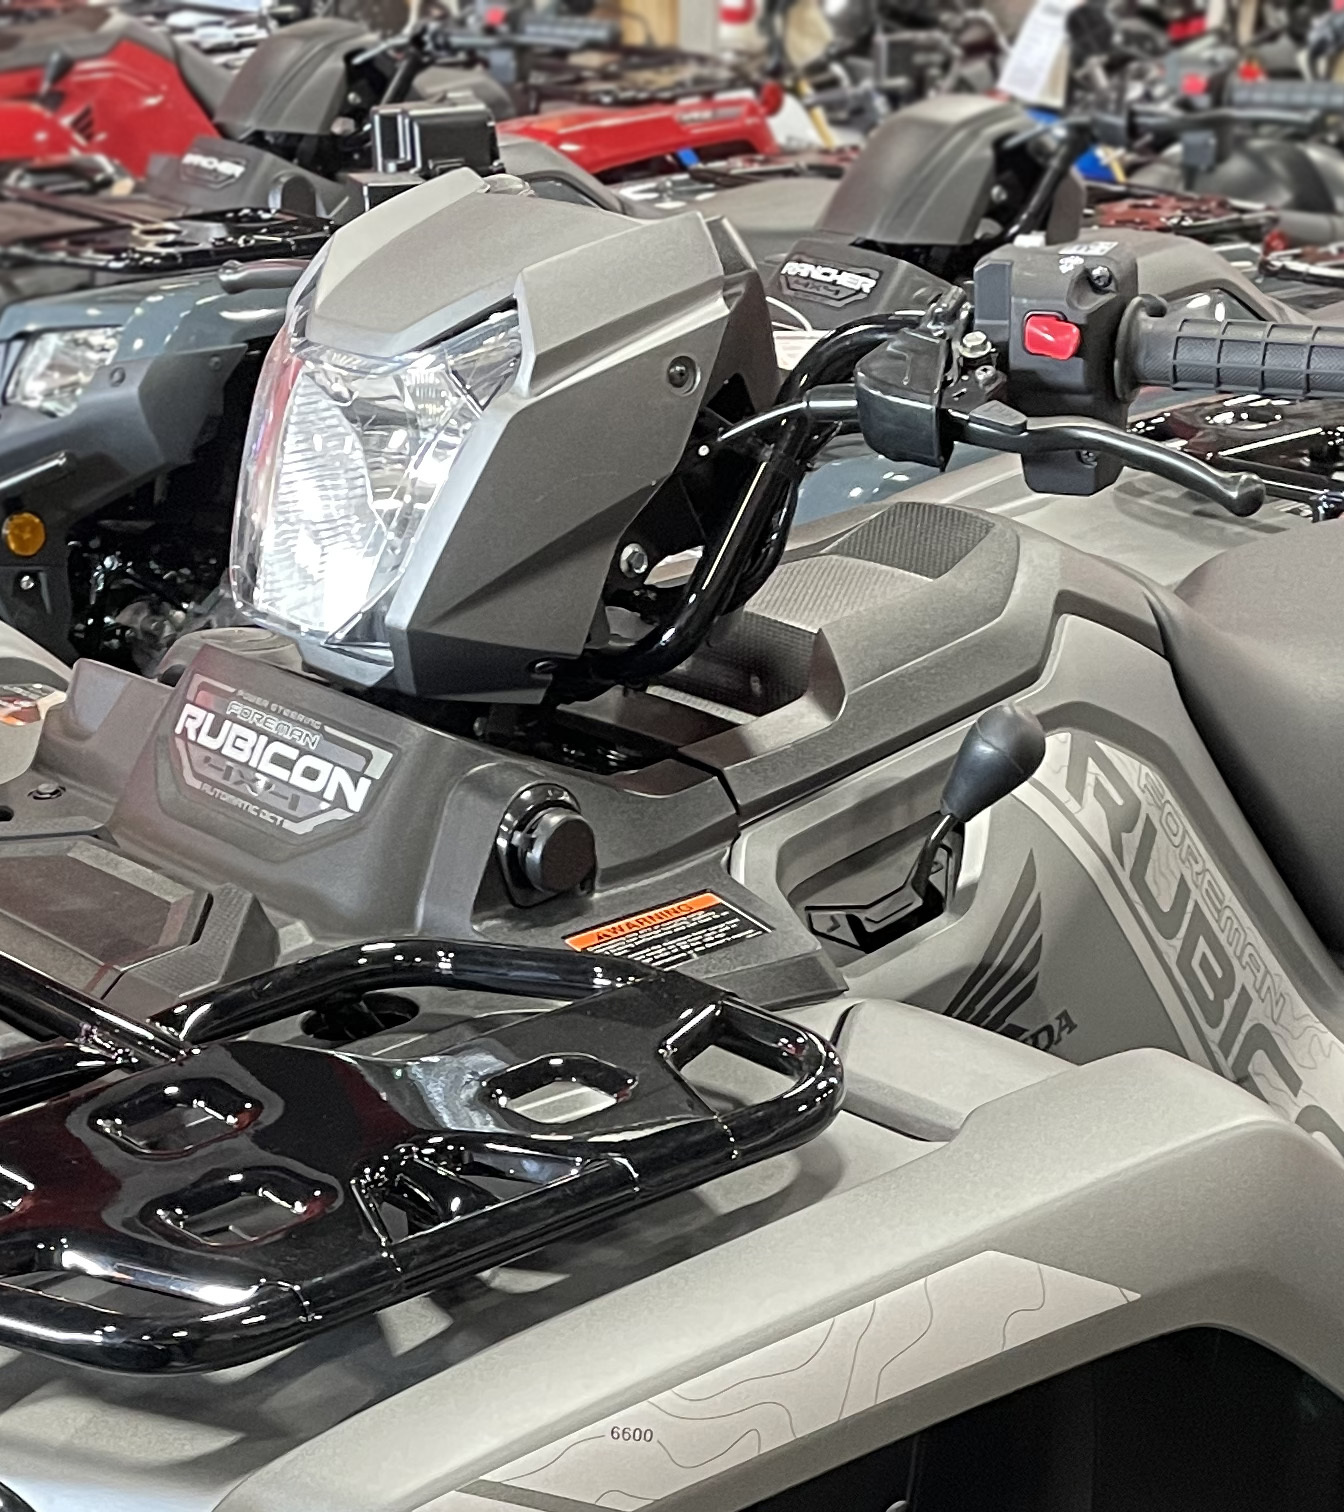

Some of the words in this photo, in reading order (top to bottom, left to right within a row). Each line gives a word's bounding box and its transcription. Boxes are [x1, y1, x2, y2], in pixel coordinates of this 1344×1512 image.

[226, 701, 323, 750] FOREMAN
[270, 703, 322, 730] STEERING
[175, 703, 371, 812] RUBICON
[200, 783, 258, 816] AUTOMATIC
[259, 807, 286, 827] DCT
[1138, 764, 1286, 1026] FOREMAN
[606, 902, 694, 936] WARNING
[610, 1426, 654, 1443] 6600
